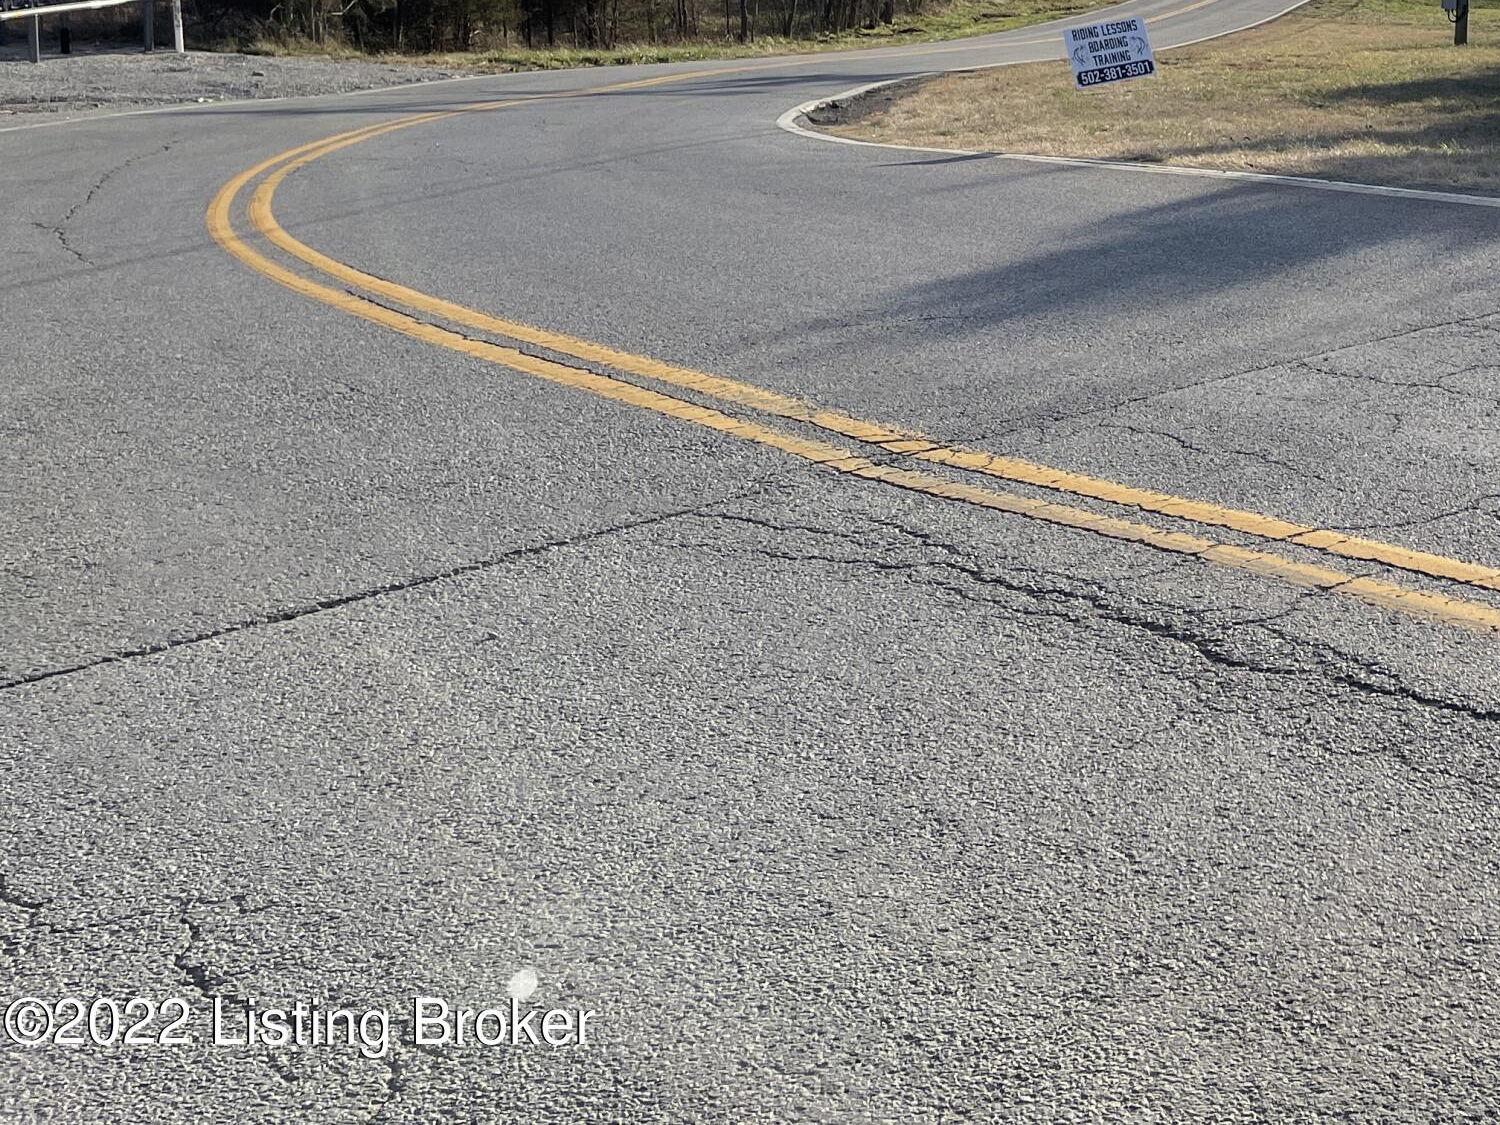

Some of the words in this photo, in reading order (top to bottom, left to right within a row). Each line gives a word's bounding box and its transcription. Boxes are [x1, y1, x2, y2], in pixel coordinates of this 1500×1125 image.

[1071, 26, 1099, 41] RIDING
[1101, 19, 1138, 36] LESSONS
[1088, 36, 1129, 53] BOARDING
[1092, 50, 1131, 67] TRAINING
[1081, 61, 1151, 85] 502-381-3501
